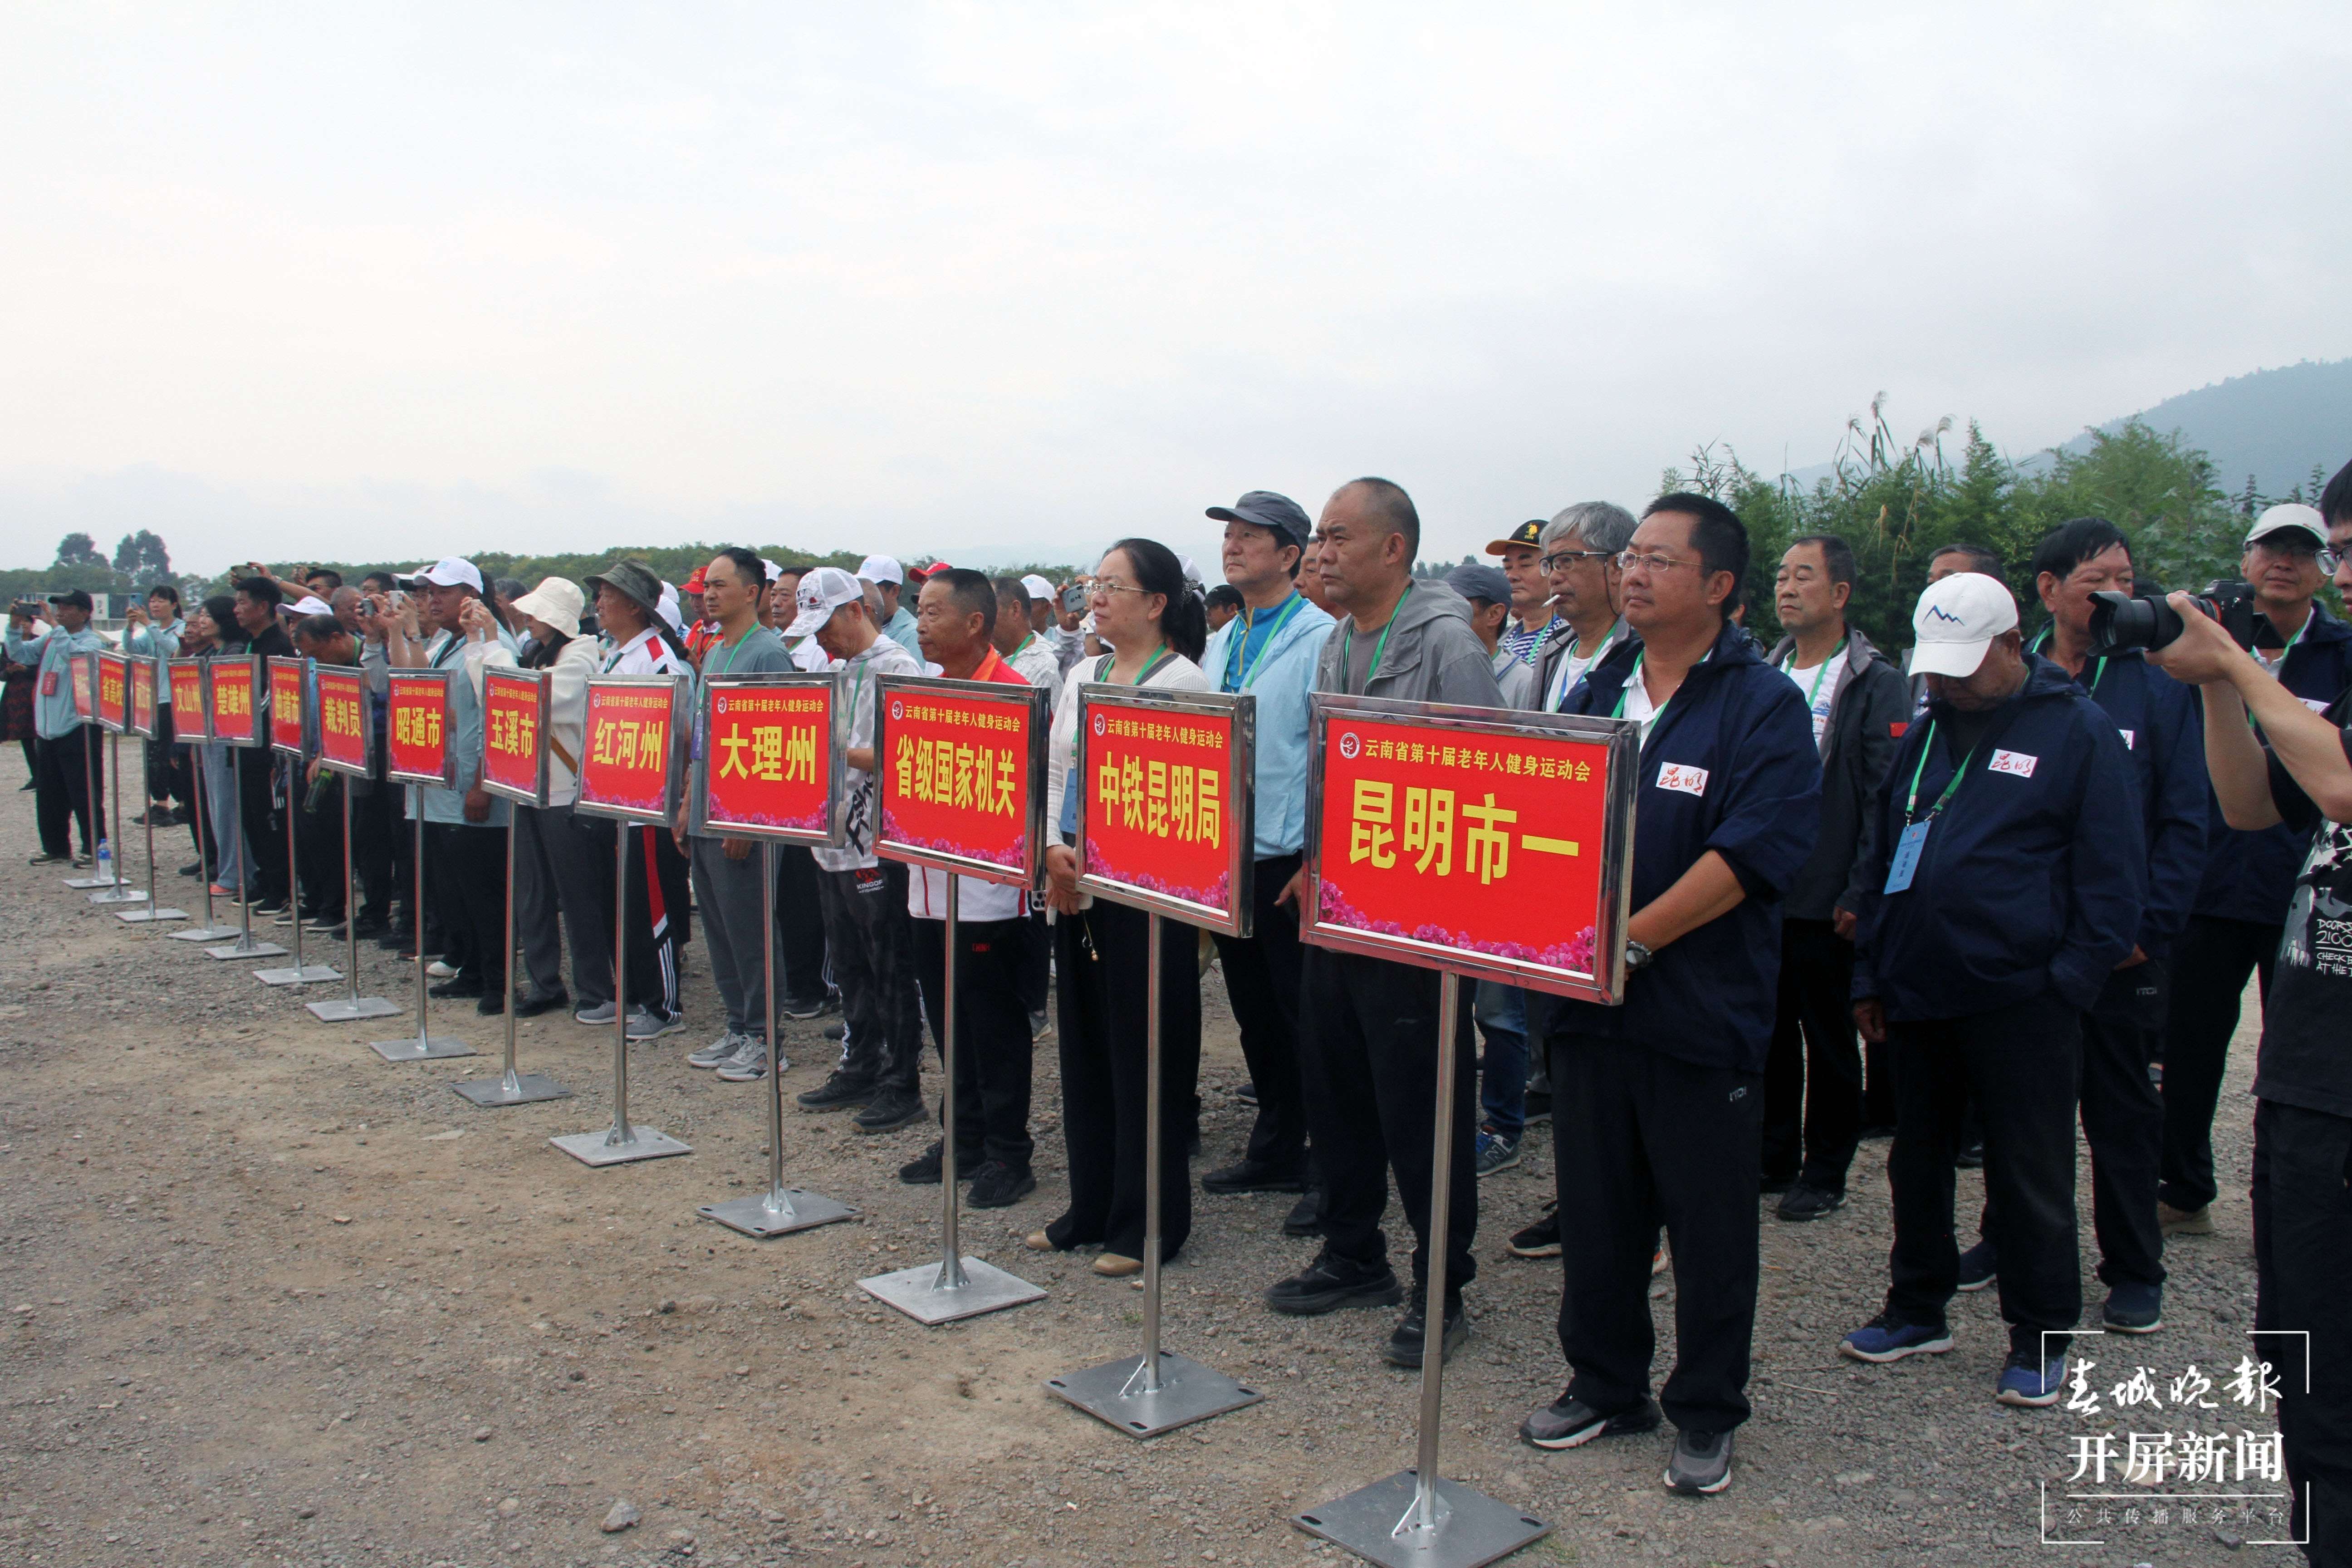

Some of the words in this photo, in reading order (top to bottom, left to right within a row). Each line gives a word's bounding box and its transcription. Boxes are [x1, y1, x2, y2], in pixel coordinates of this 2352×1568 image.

[217, 684, 250, 715] 楚雄州
[325, 697, 361, 737] 裁判员
[601, 696, 668, 708] 云南省第十届老年人健身运动会
[728, 699, 823, 712] 云南省第十届老年人健身运动会
[905, 706, 1020, 732] 云南省第十届老年人健身运动会
[397, 707, 441, 748] 昭通市
[490, 709, 534, 758] 玉溪市
[593, 717, 663, 772] 红河州
[1107, 719, 1223, 749] 云南省第十届老年人健身运动会
[719, 723, 816, 784] 大理州
[1365, 739, 1591, 783] 云南省第十届老年人健身运动会
[1991, 753, 2032, 775] 昆明
[896, 734, 1016, 818] 省级国家机关
[1659, 767, 1702, 793] 昆明
[1099, 751, 1220, 849] 中铁昆明局
[1349, 779, 1579, 885] 昆明市一
[857, 879, 883, 890] KINGOF
